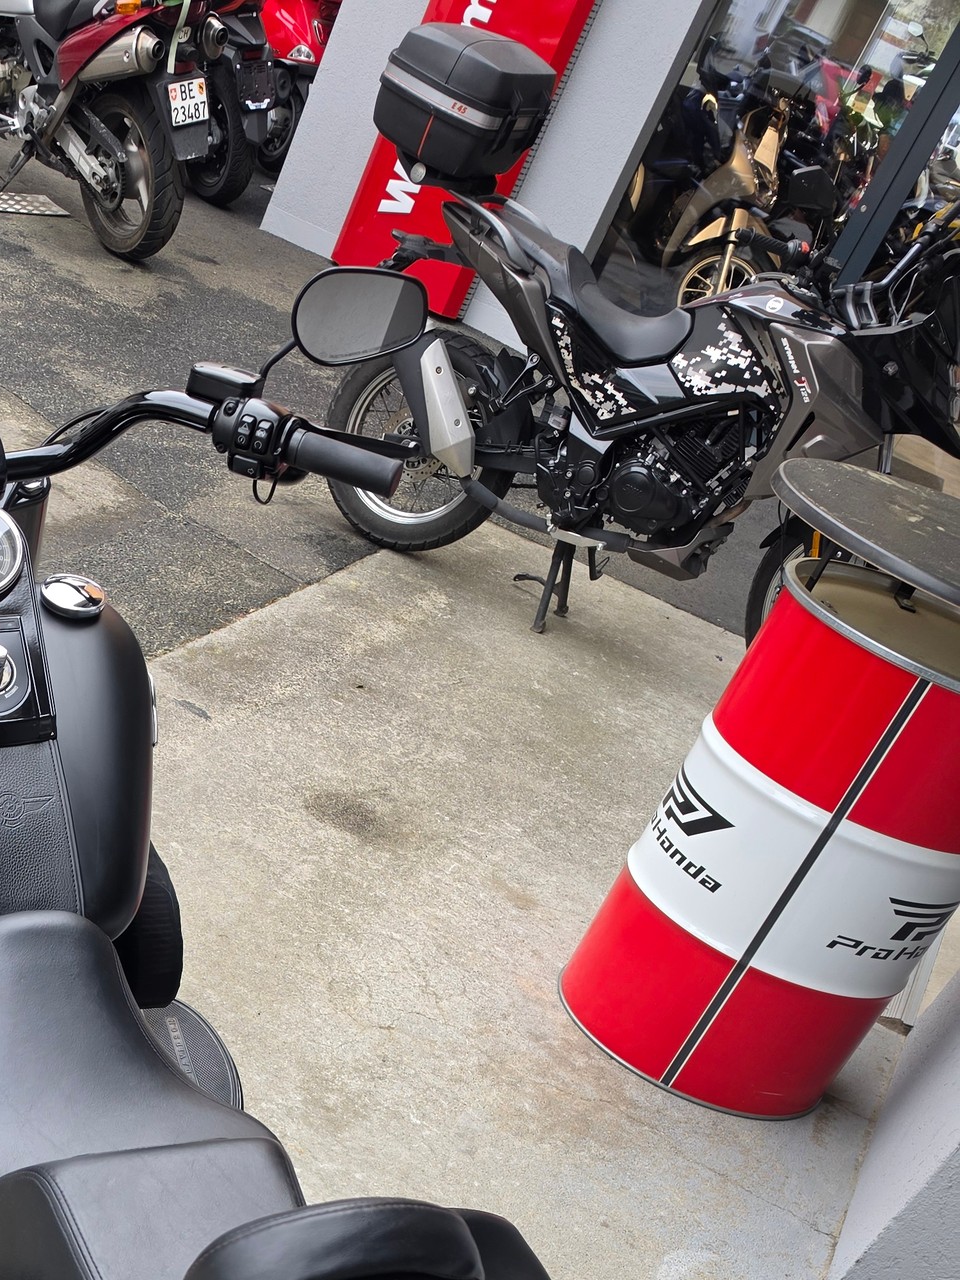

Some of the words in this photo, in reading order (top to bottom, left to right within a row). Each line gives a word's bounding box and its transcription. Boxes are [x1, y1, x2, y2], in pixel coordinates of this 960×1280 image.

[180, 82, 195, 101] BE
[173, 101, 206, 124] 23487
[451, 102, 458, 111] E
[457, 105, 468, 114] 45
